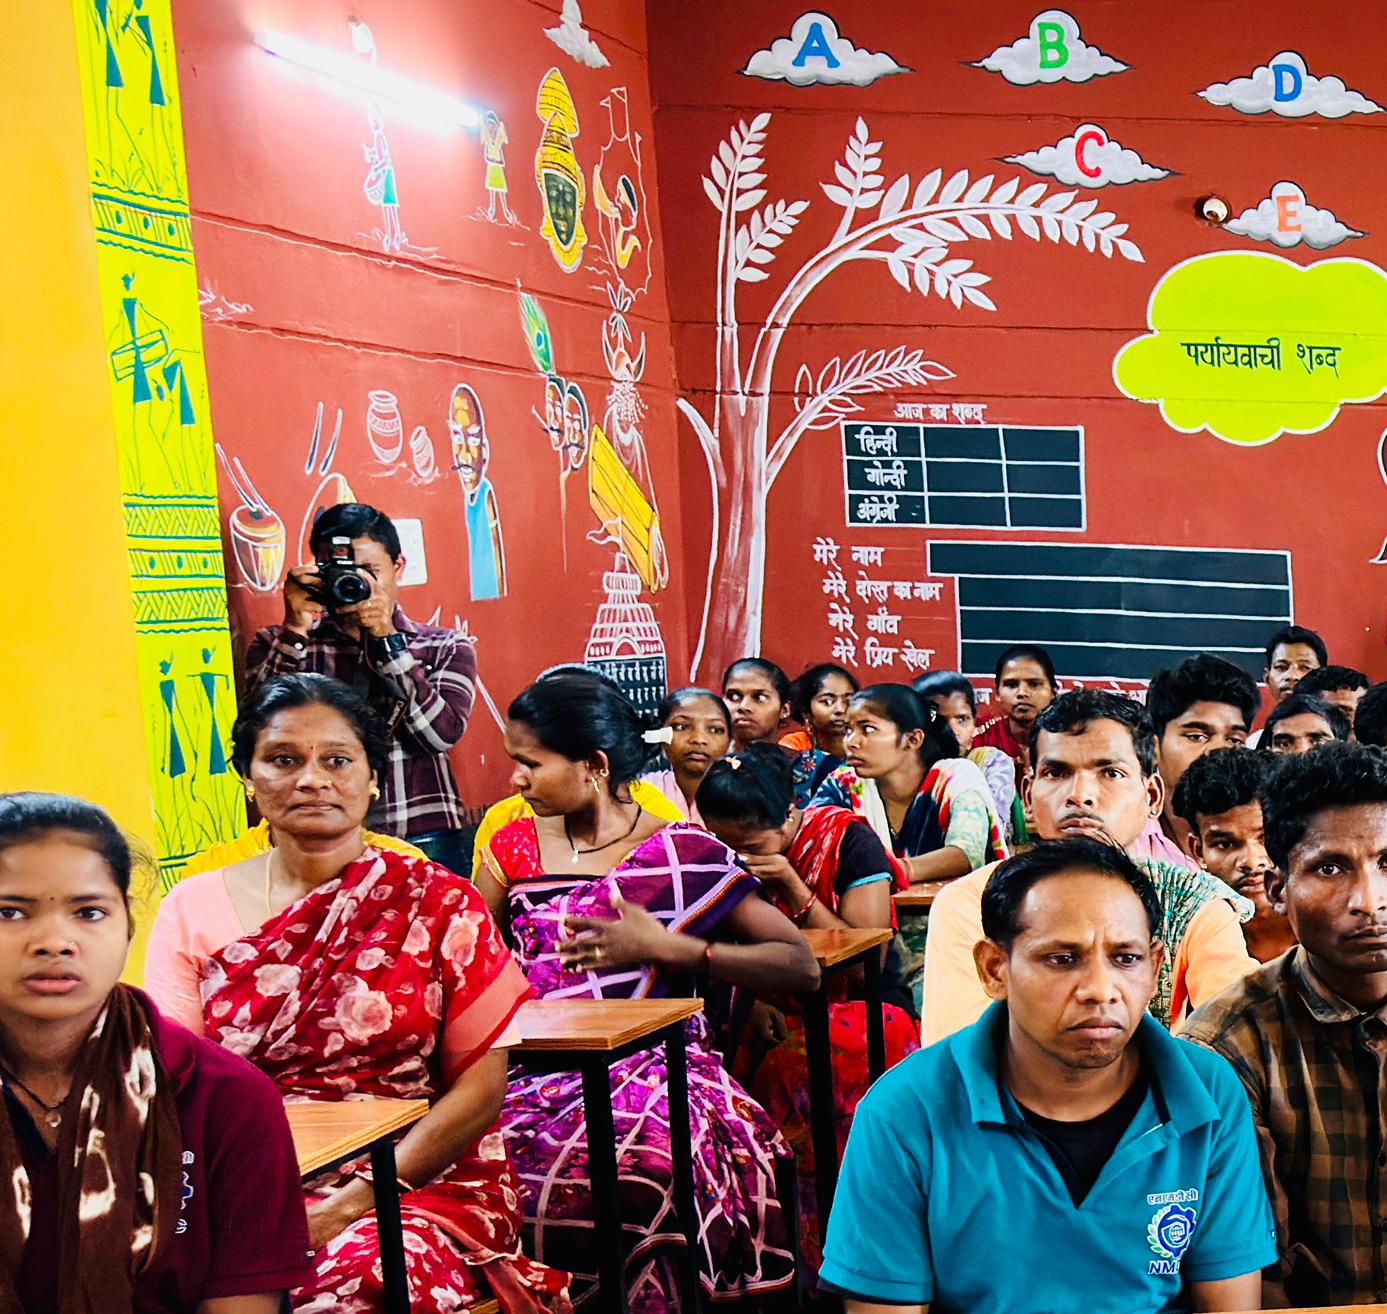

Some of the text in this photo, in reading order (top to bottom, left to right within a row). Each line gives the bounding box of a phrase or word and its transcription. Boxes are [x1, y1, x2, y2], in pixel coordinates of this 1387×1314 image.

[792, 22, 841, 70] A
[1038, 22, 1069, 69] B
[1271, 64, 1303, 103] D
[1075, 131, 1105, 179] C
[1276, 195, 1302, 232] E
[1180, 336, 1342, 378] पर्यायवाची शब्द
[894, 403, 926, 420] आज
[927, 403, 949, 421] का
[855, 426, 897, 456] हिन्दी
[851, 546, 884, 566] नाम
[855, 571, 892, 603] दोस्त
[893, 581, 912, 600] का
[913, 582, 943, 600] नाम
[864, 637, 898, 667] प्रिय
[900, 640, 935, 672] खेल
